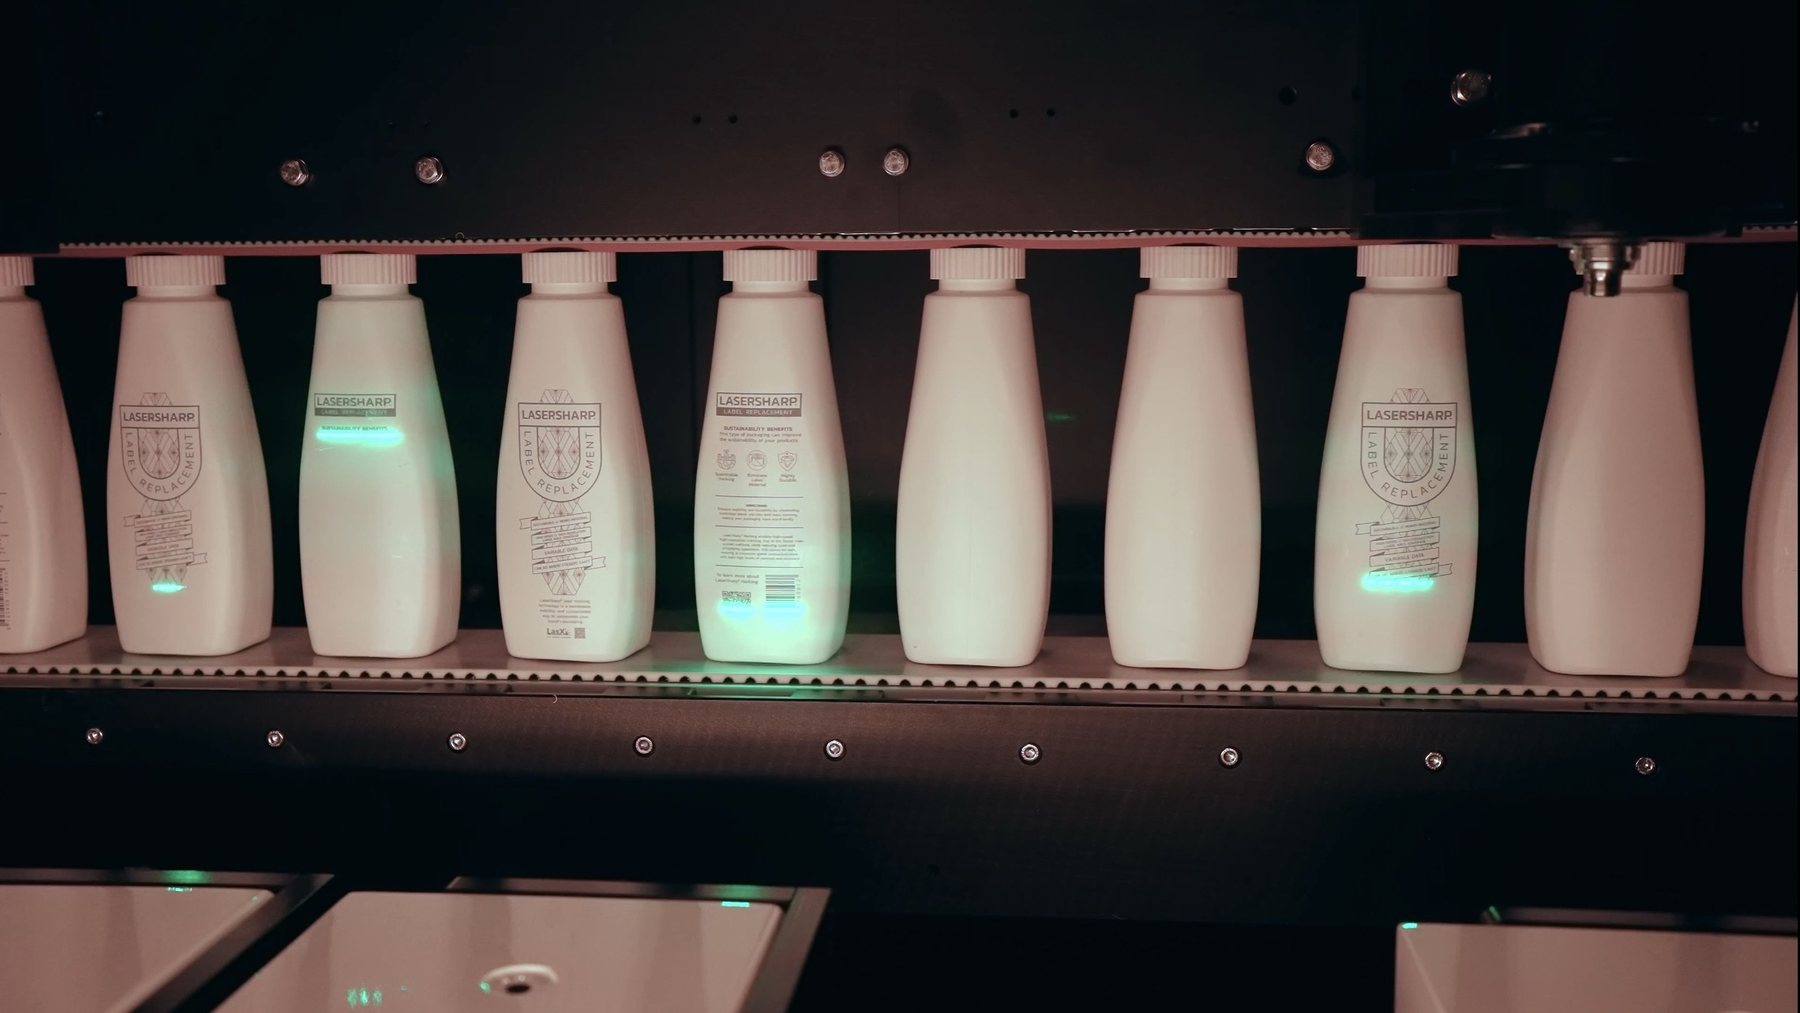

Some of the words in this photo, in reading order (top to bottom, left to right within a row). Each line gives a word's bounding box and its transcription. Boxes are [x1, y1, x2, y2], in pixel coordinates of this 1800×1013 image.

[317, 397, 392, 407] LASERSHARP
[720, 396, 798, 406] LASERSHARP
[123, 412, 196, 422] LASERSHARP
[522, 410, 596, 420] LASERSHARP
[1367, 410, 1453, 420] LASERSHARP
[126, 431, 137, 475] LABEL
[139, 434, 195, 494] REPLACEMENT
[524, 430, 535, 475] LABEL
[537, 432, 595, 494] REPLACEMENT
[1368, 431, 1379, 478] LABEL
[1381, 433, 1449, 498] REPLACEMENT
